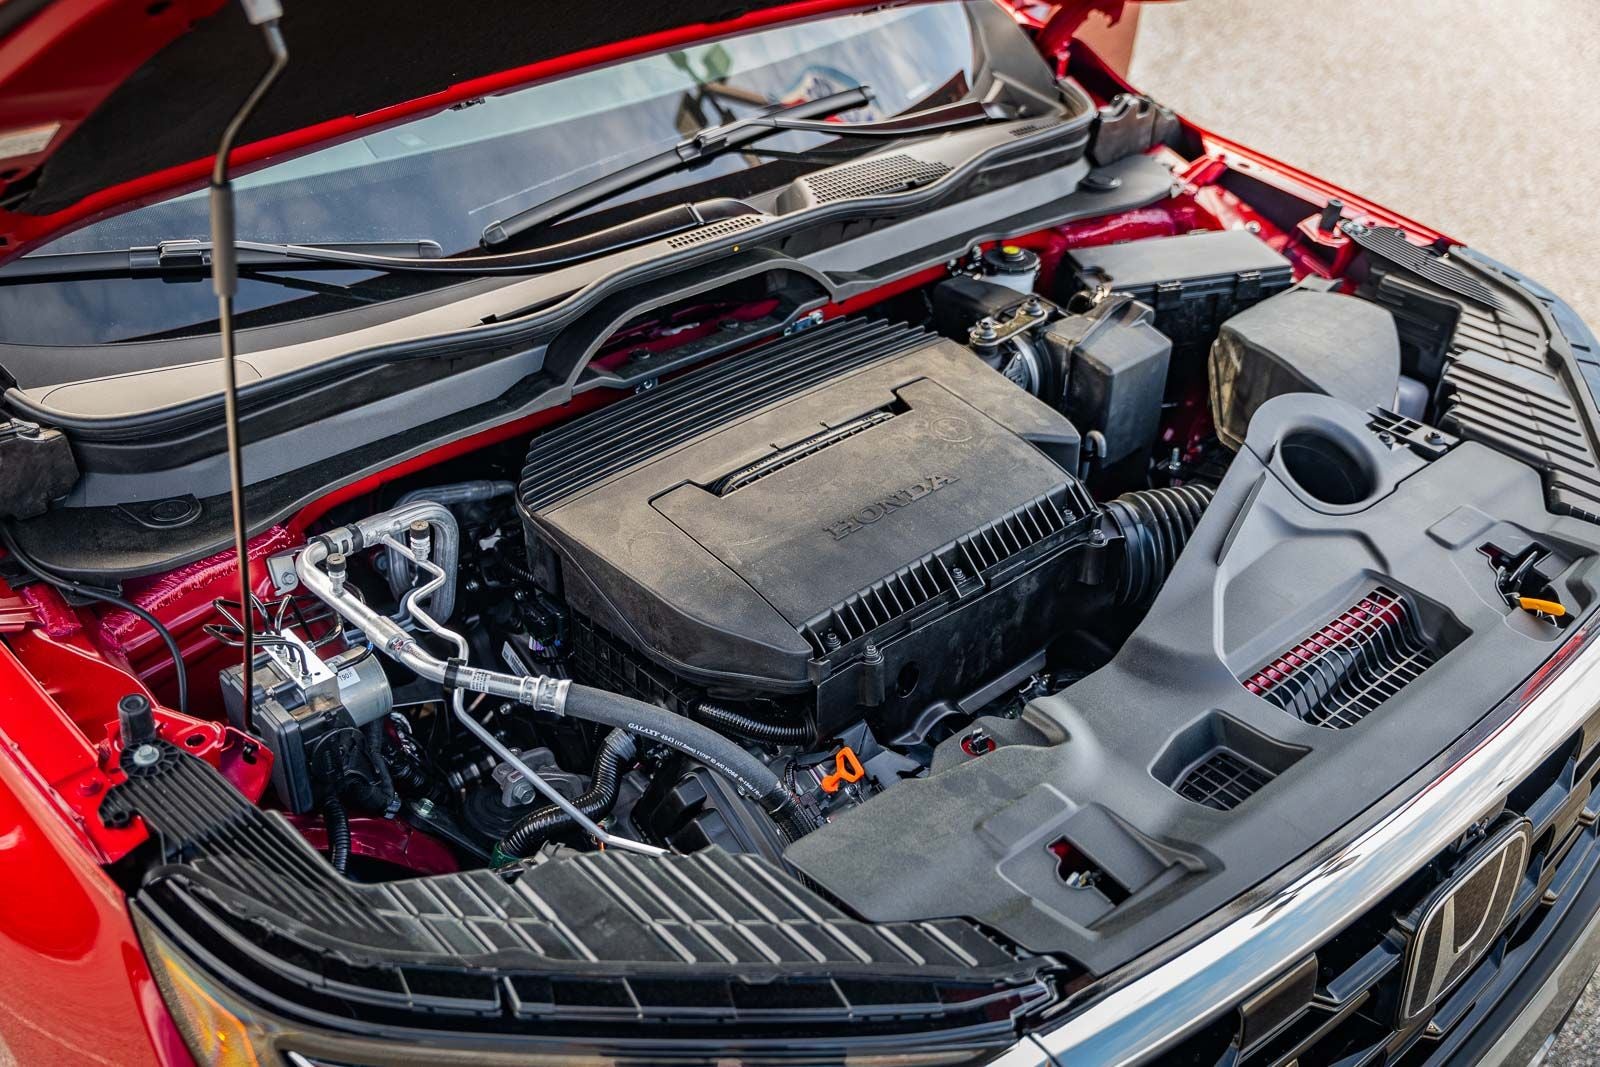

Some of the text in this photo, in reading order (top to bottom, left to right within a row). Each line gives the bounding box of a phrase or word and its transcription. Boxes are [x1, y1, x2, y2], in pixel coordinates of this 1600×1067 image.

[822, 472, 961, 541] HONDA
[627, 722, 661, 737] GALAXY
[724, 766, 739, 778] HOSE
